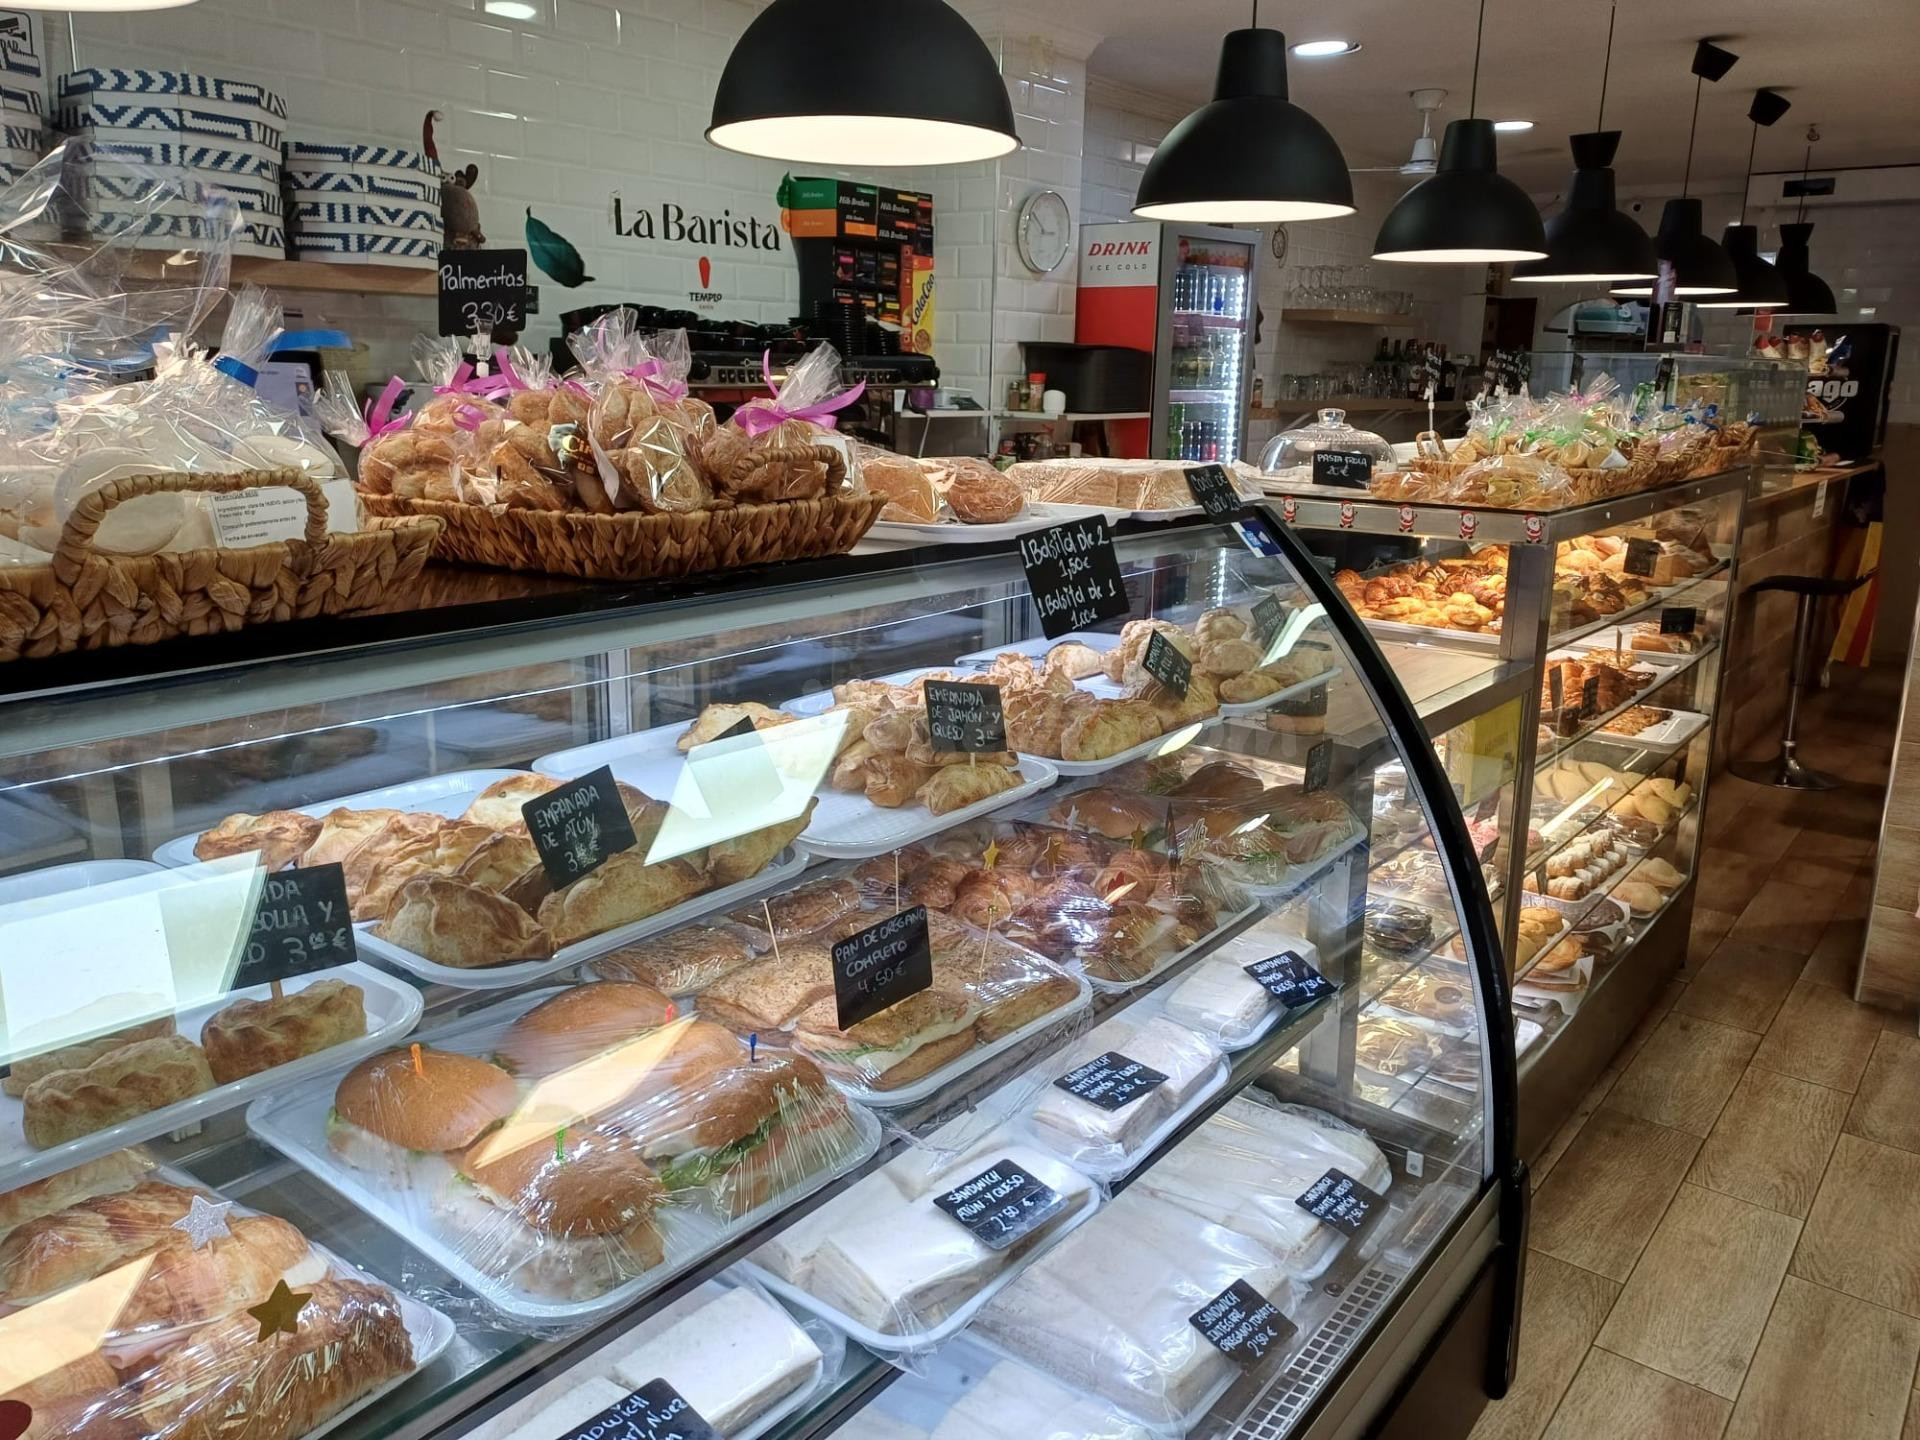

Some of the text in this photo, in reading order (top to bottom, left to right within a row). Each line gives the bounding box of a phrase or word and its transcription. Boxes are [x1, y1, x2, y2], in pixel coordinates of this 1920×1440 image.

[614, 197, 781, 251] La Barista
[1088, 240, 1152, 257] DRINK
[439, 264, 525, 291] Palmeritas
[1090, 263, 1148, 272] ICE COLD
[928, 687, 985, 706] EMPANADA
[932, 705, 943, 718] DE
[932, 722, 964, 741] QUESO
[535, 785, 600, 828] EMPANADA
[542, 811, 595, 850] DE ATÚN
[835, 908, 926, 962] PAN DE OREGANO
[846, 940, 908, 977] COMPLETO
[1253, 955, 1293, 973] SANDWICH
[1065, 1055, 1112, 1083] SANDWICH
[1070, 1068, 1117, 1093] INTEGRAL
[947, 1170, 1002, 1203] SANDWICH
[957, 1200, 986, 1220] ATÚN
[993, 1174, 1025, 1198] QUESO
[1304, 1176, 1335, 1203] SANDWICH
[1198, 1290, 1240, 1327] SANDWICH
[1207, 1308, 1246, 1341] INTEGRAL
